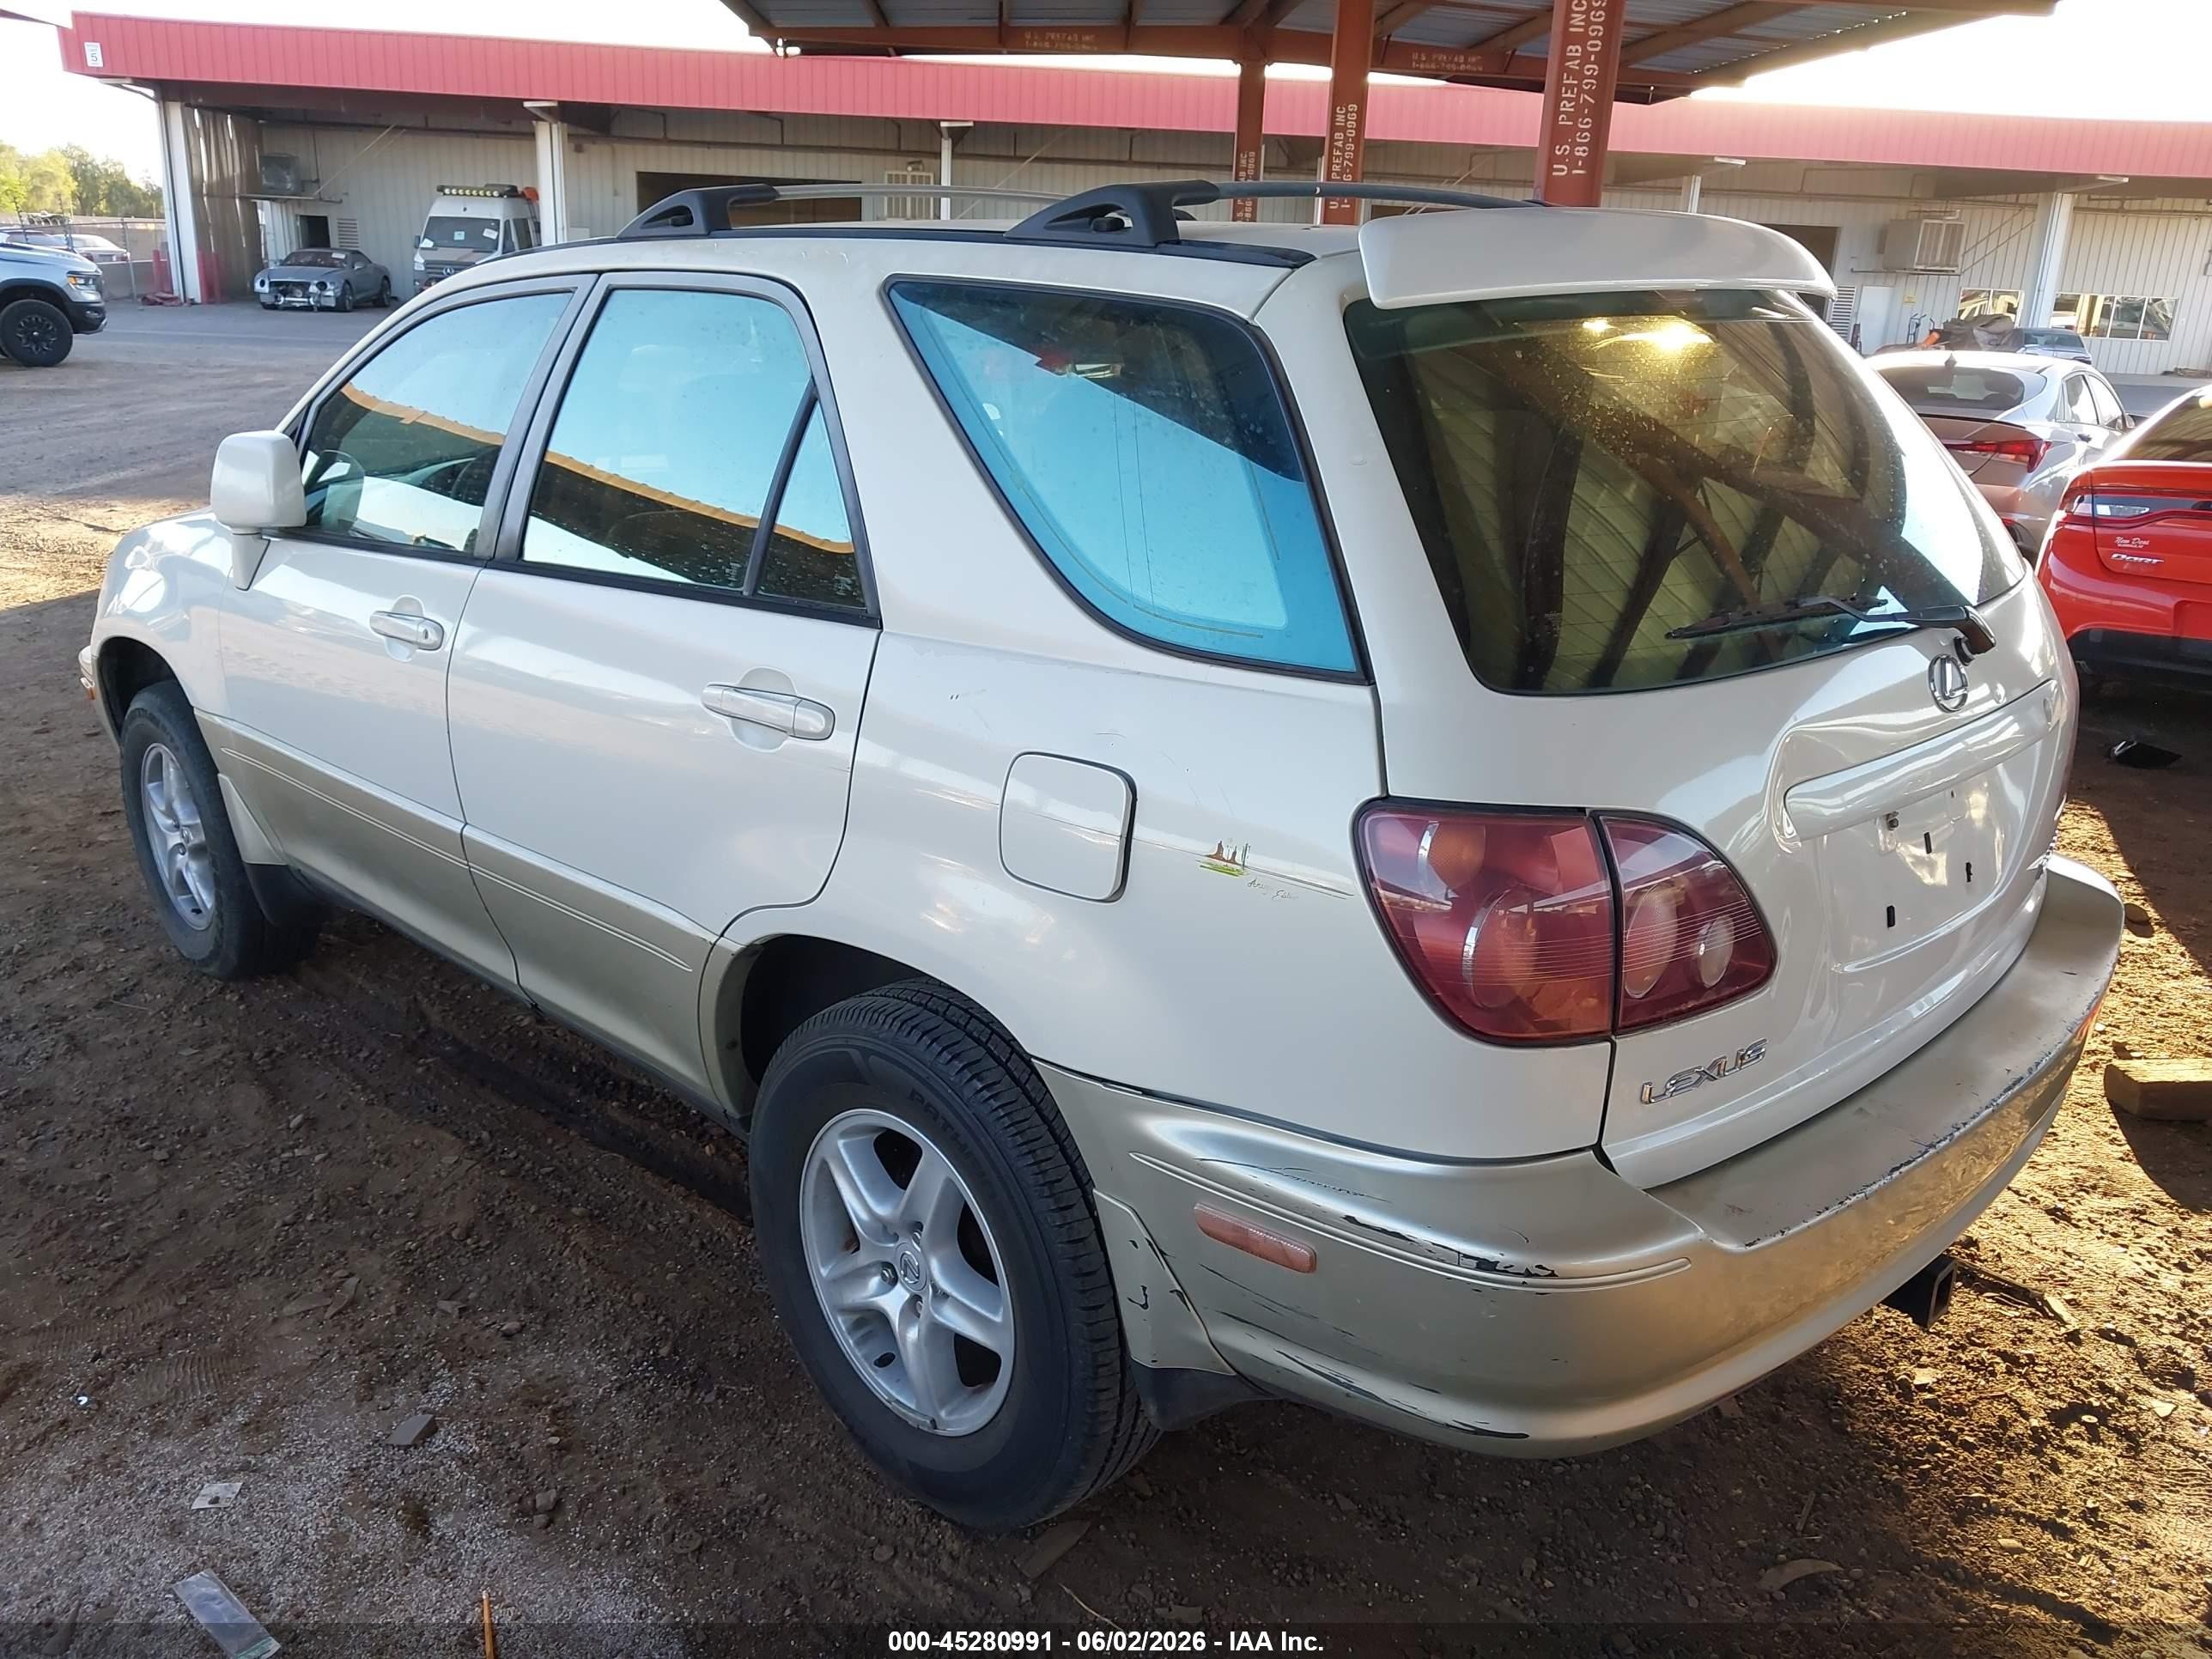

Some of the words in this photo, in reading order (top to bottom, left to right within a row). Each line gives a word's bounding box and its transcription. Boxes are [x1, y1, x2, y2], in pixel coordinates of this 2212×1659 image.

[1559, 45, 1582, 125] PREFAB
[1332, 131, 1345, 179] PREFAB
[1553, 138, 1571, 176] U.S.
[1641, 1037, 1769, 1105] LEXUS
